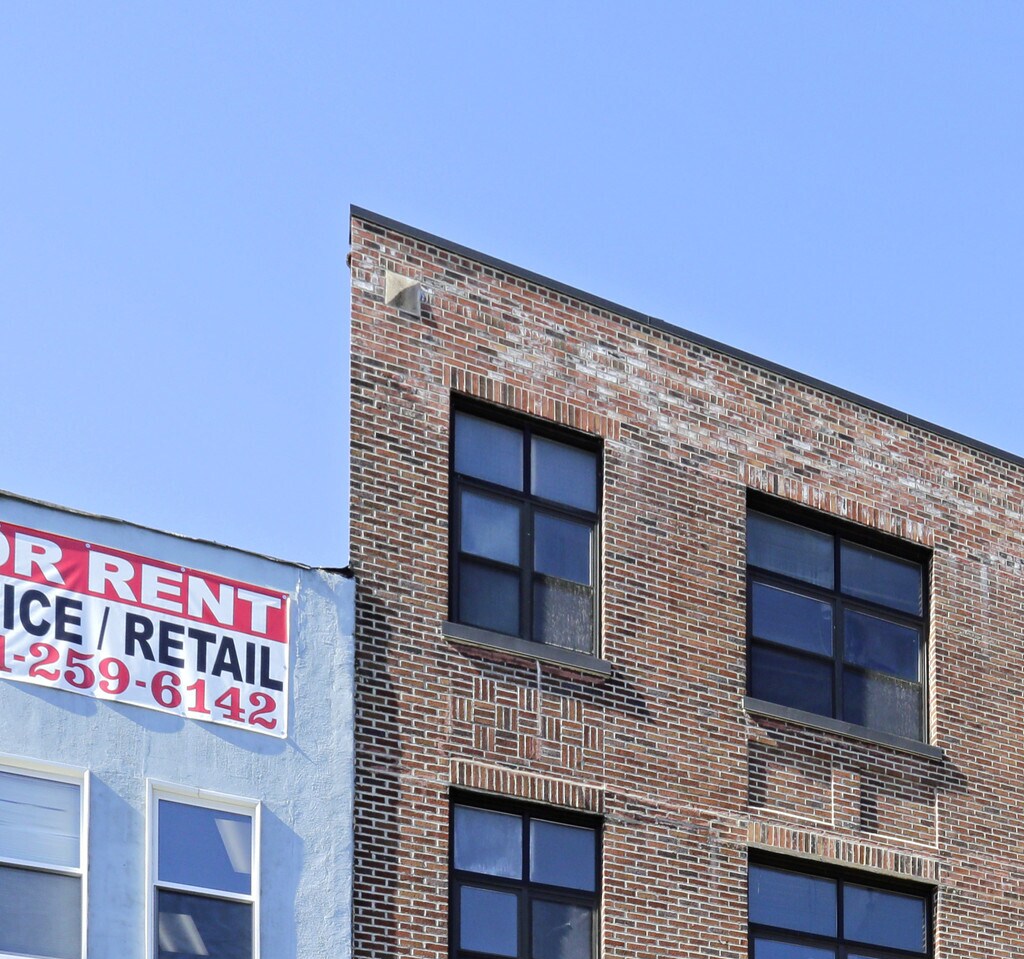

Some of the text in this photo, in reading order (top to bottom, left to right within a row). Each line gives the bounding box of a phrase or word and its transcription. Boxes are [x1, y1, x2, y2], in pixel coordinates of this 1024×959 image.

[3, 584, 284, 692] ICE / RETAIL
[88, 550, 281, 635] RENT
